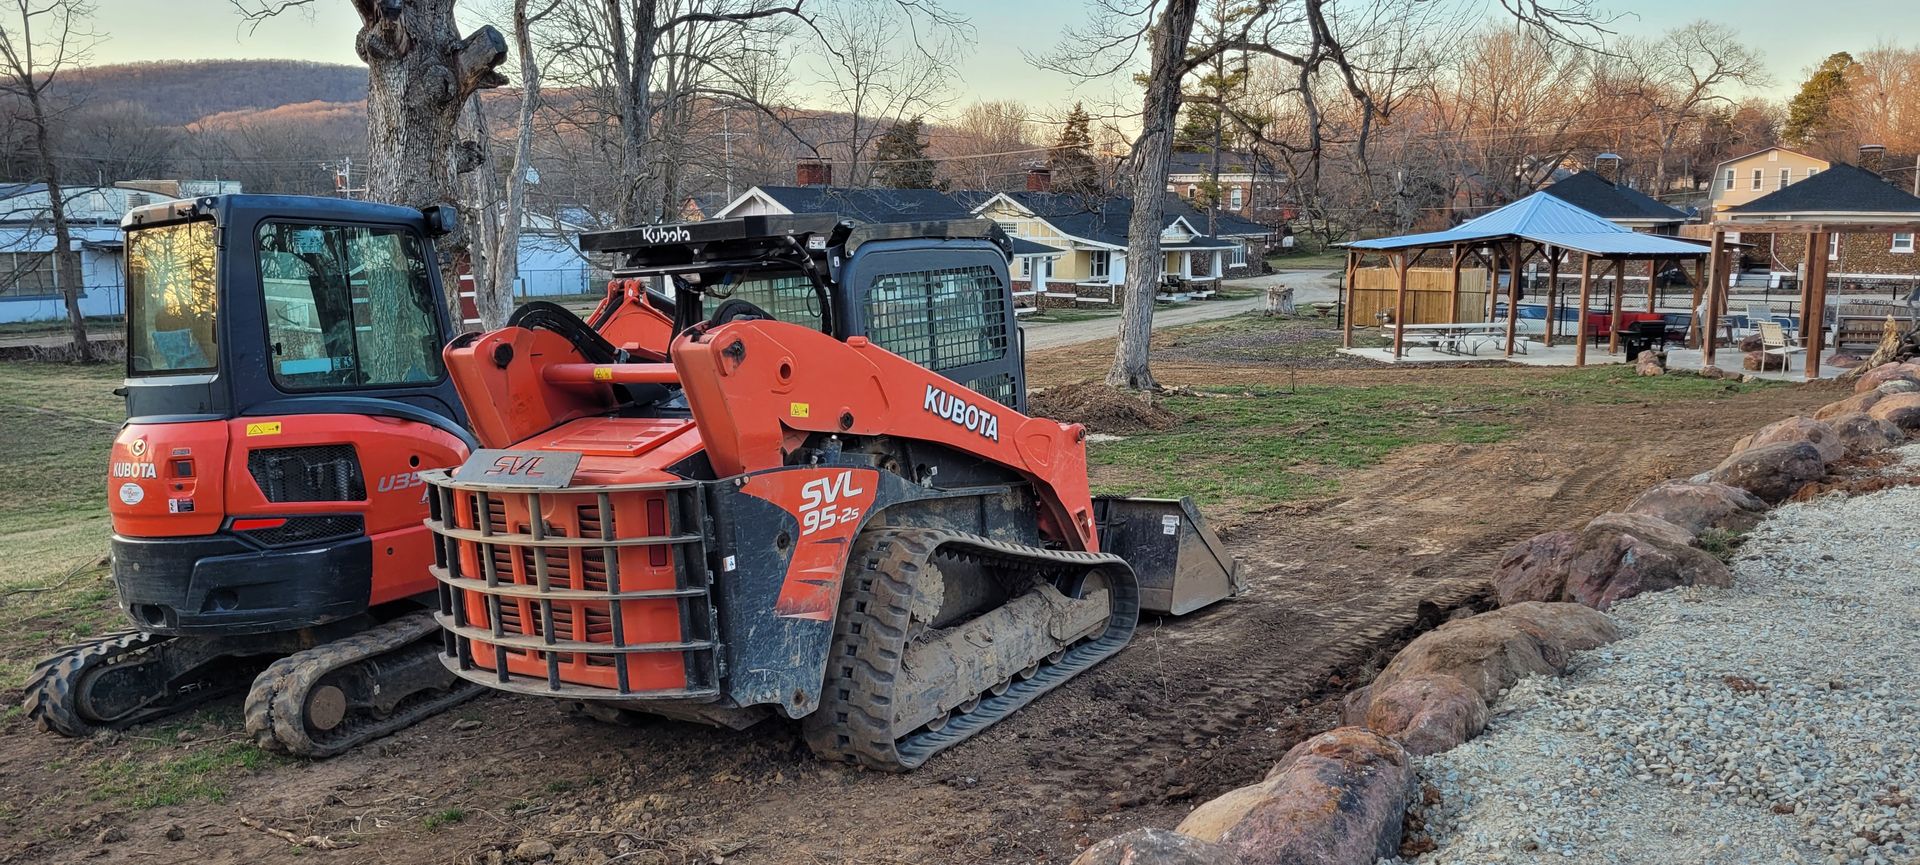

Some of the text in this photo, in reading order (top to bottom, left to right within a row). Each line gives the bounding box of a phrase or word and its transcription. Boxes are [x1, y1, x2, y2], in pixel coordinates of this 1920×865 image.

[642, 226, 691, 244] Kubota
[923, 383, 999, 443] KUBOTA
[113, 462, 157, 479] KUBOTA
[484, 455, 545, 478] SVL
[798, 470, 864, 513] SVL
